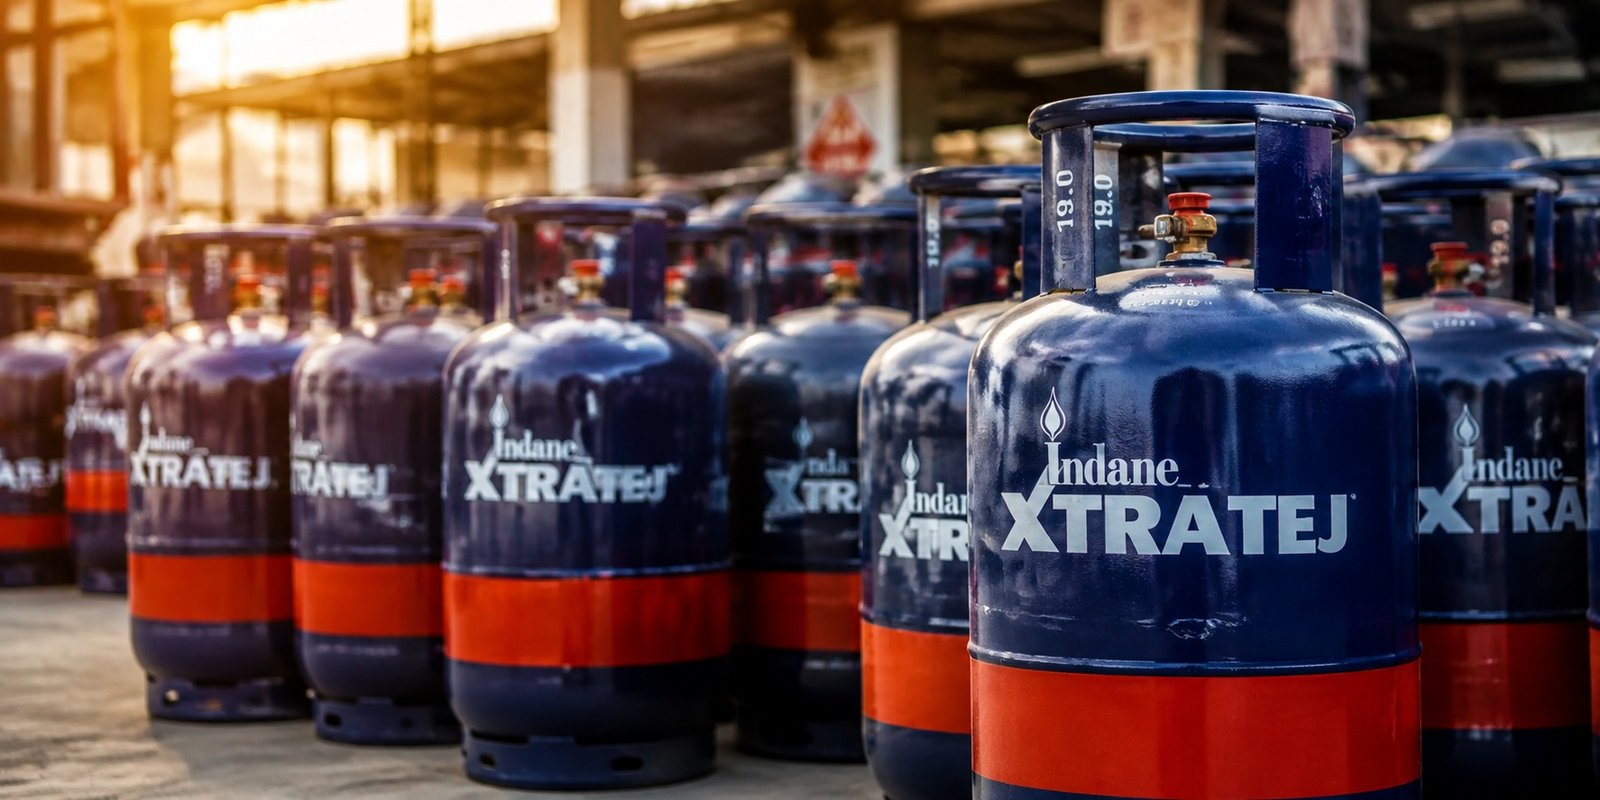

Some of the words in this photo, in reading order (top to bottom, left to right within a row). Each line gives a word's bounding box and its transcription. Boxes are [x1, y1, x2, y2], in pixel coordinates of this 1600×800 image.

[1056, 169, 1074, 233] 19.0
[1094, 174, 1114, 231] 19.0
[492, 428, 577, 462] Indane
[1045, 442, 1180, 487] Indane
[1460, 446, 1564, 482] Indane
[130, 450, 272, 491] XTRATEJ
[464, 457, 669, 504] XTRATEJ
[763, 468, 862, 514] XTR
[1000, 482, 1349, 556] XTRATEJ
[1418, 480, 1588, 534] XTRA
